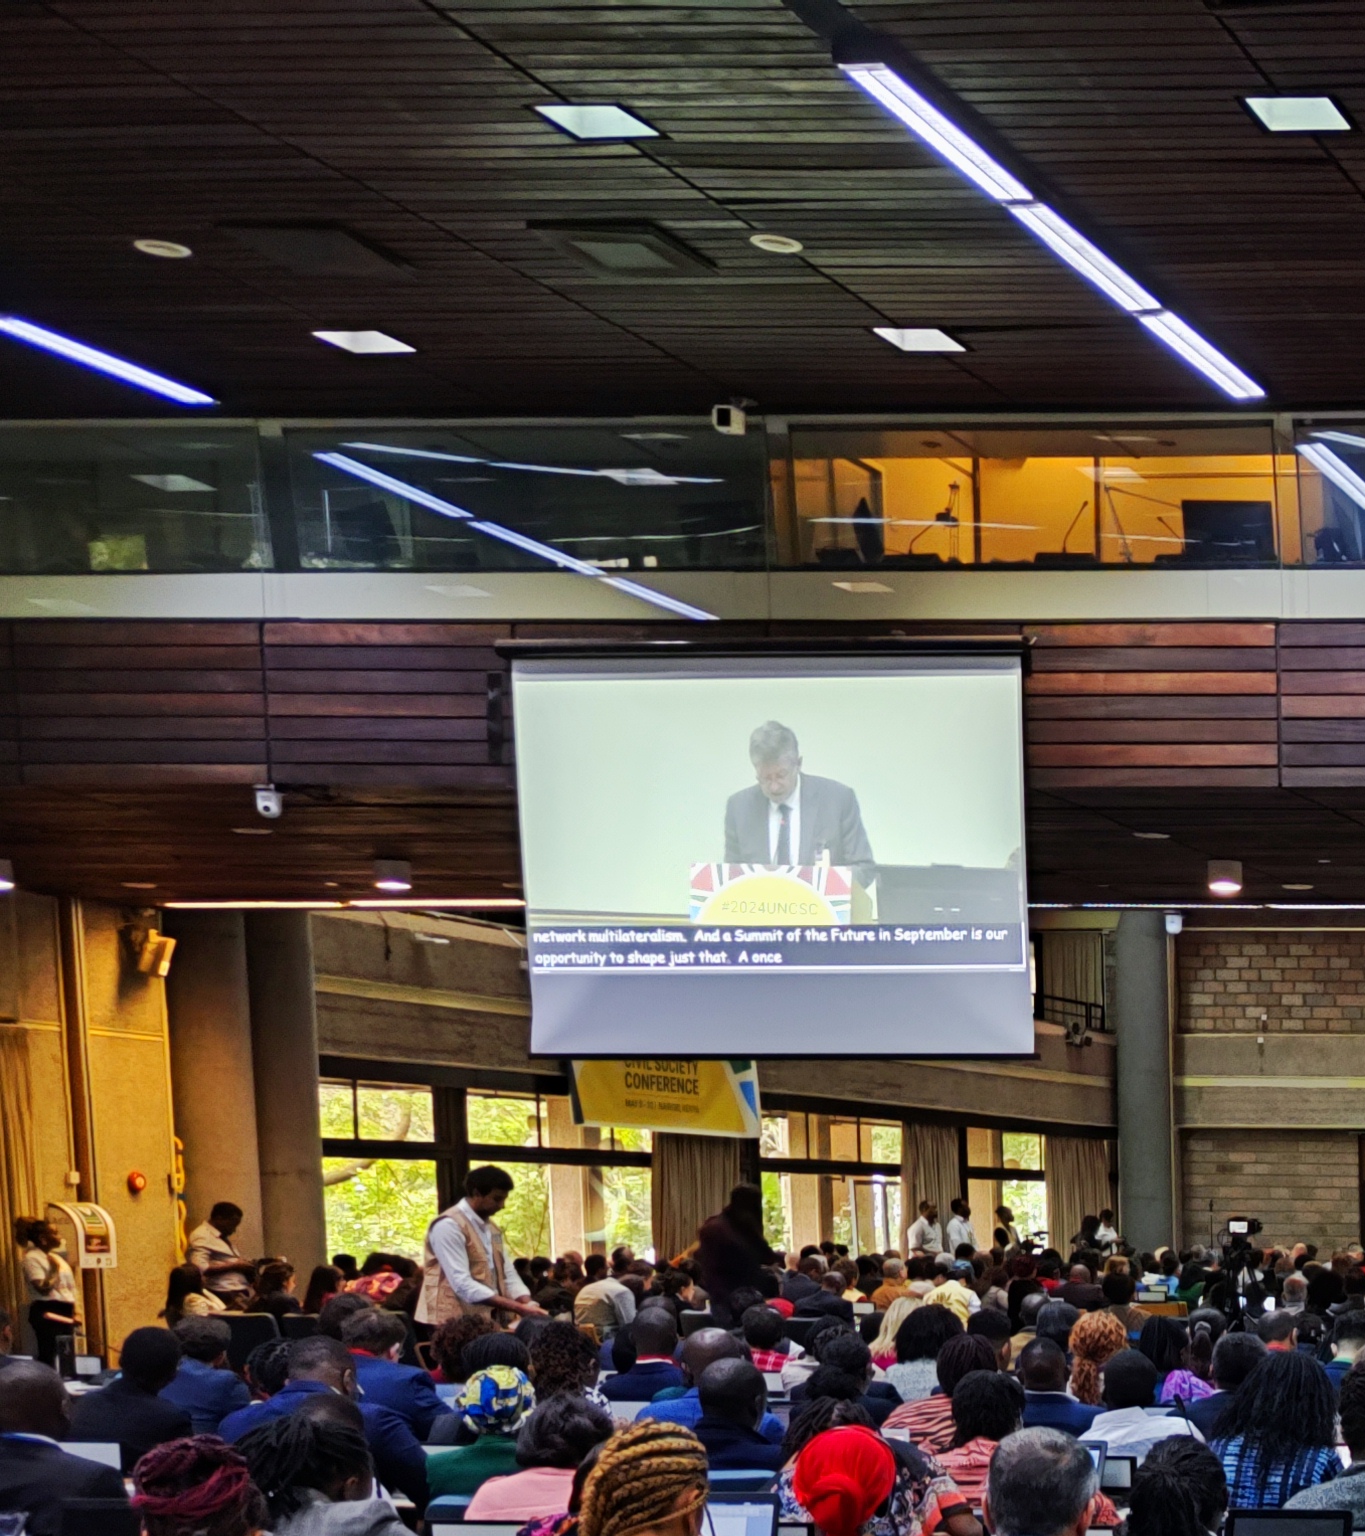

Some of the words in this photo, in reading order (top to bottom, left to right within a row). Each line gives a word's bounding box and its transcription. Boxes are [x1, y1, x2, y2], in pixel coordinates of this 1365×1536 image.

[721, 899, 818, 916] #2024UNCSC
[533, 929, 587, 943] network
[589, 929, 687, 943] multilateralism.
[694, 929, 720, 942] And
[723, 932, 732, 942] a
[735, 928, 784, 942] Summit
[786, 928, 801, 942] of
[805, 928, 828, 942] the
[831, 928, 876, 942] Future
[879, 928, 891, 941] in
[894, 927, 968, 945] September
[971, 927, 982, 940] is
[985, 930, 1008, 941] our
[535, 951, 607, 966] opportunity
[610, 952, 624, 964] to
[627, 950, 666, 967] shape
[669, 951, 695, 966] just
[738, 951, 748, 963] A
[752, 953, 783, 963] once
[625, 1072, 699, 1095] CONFERENCE
